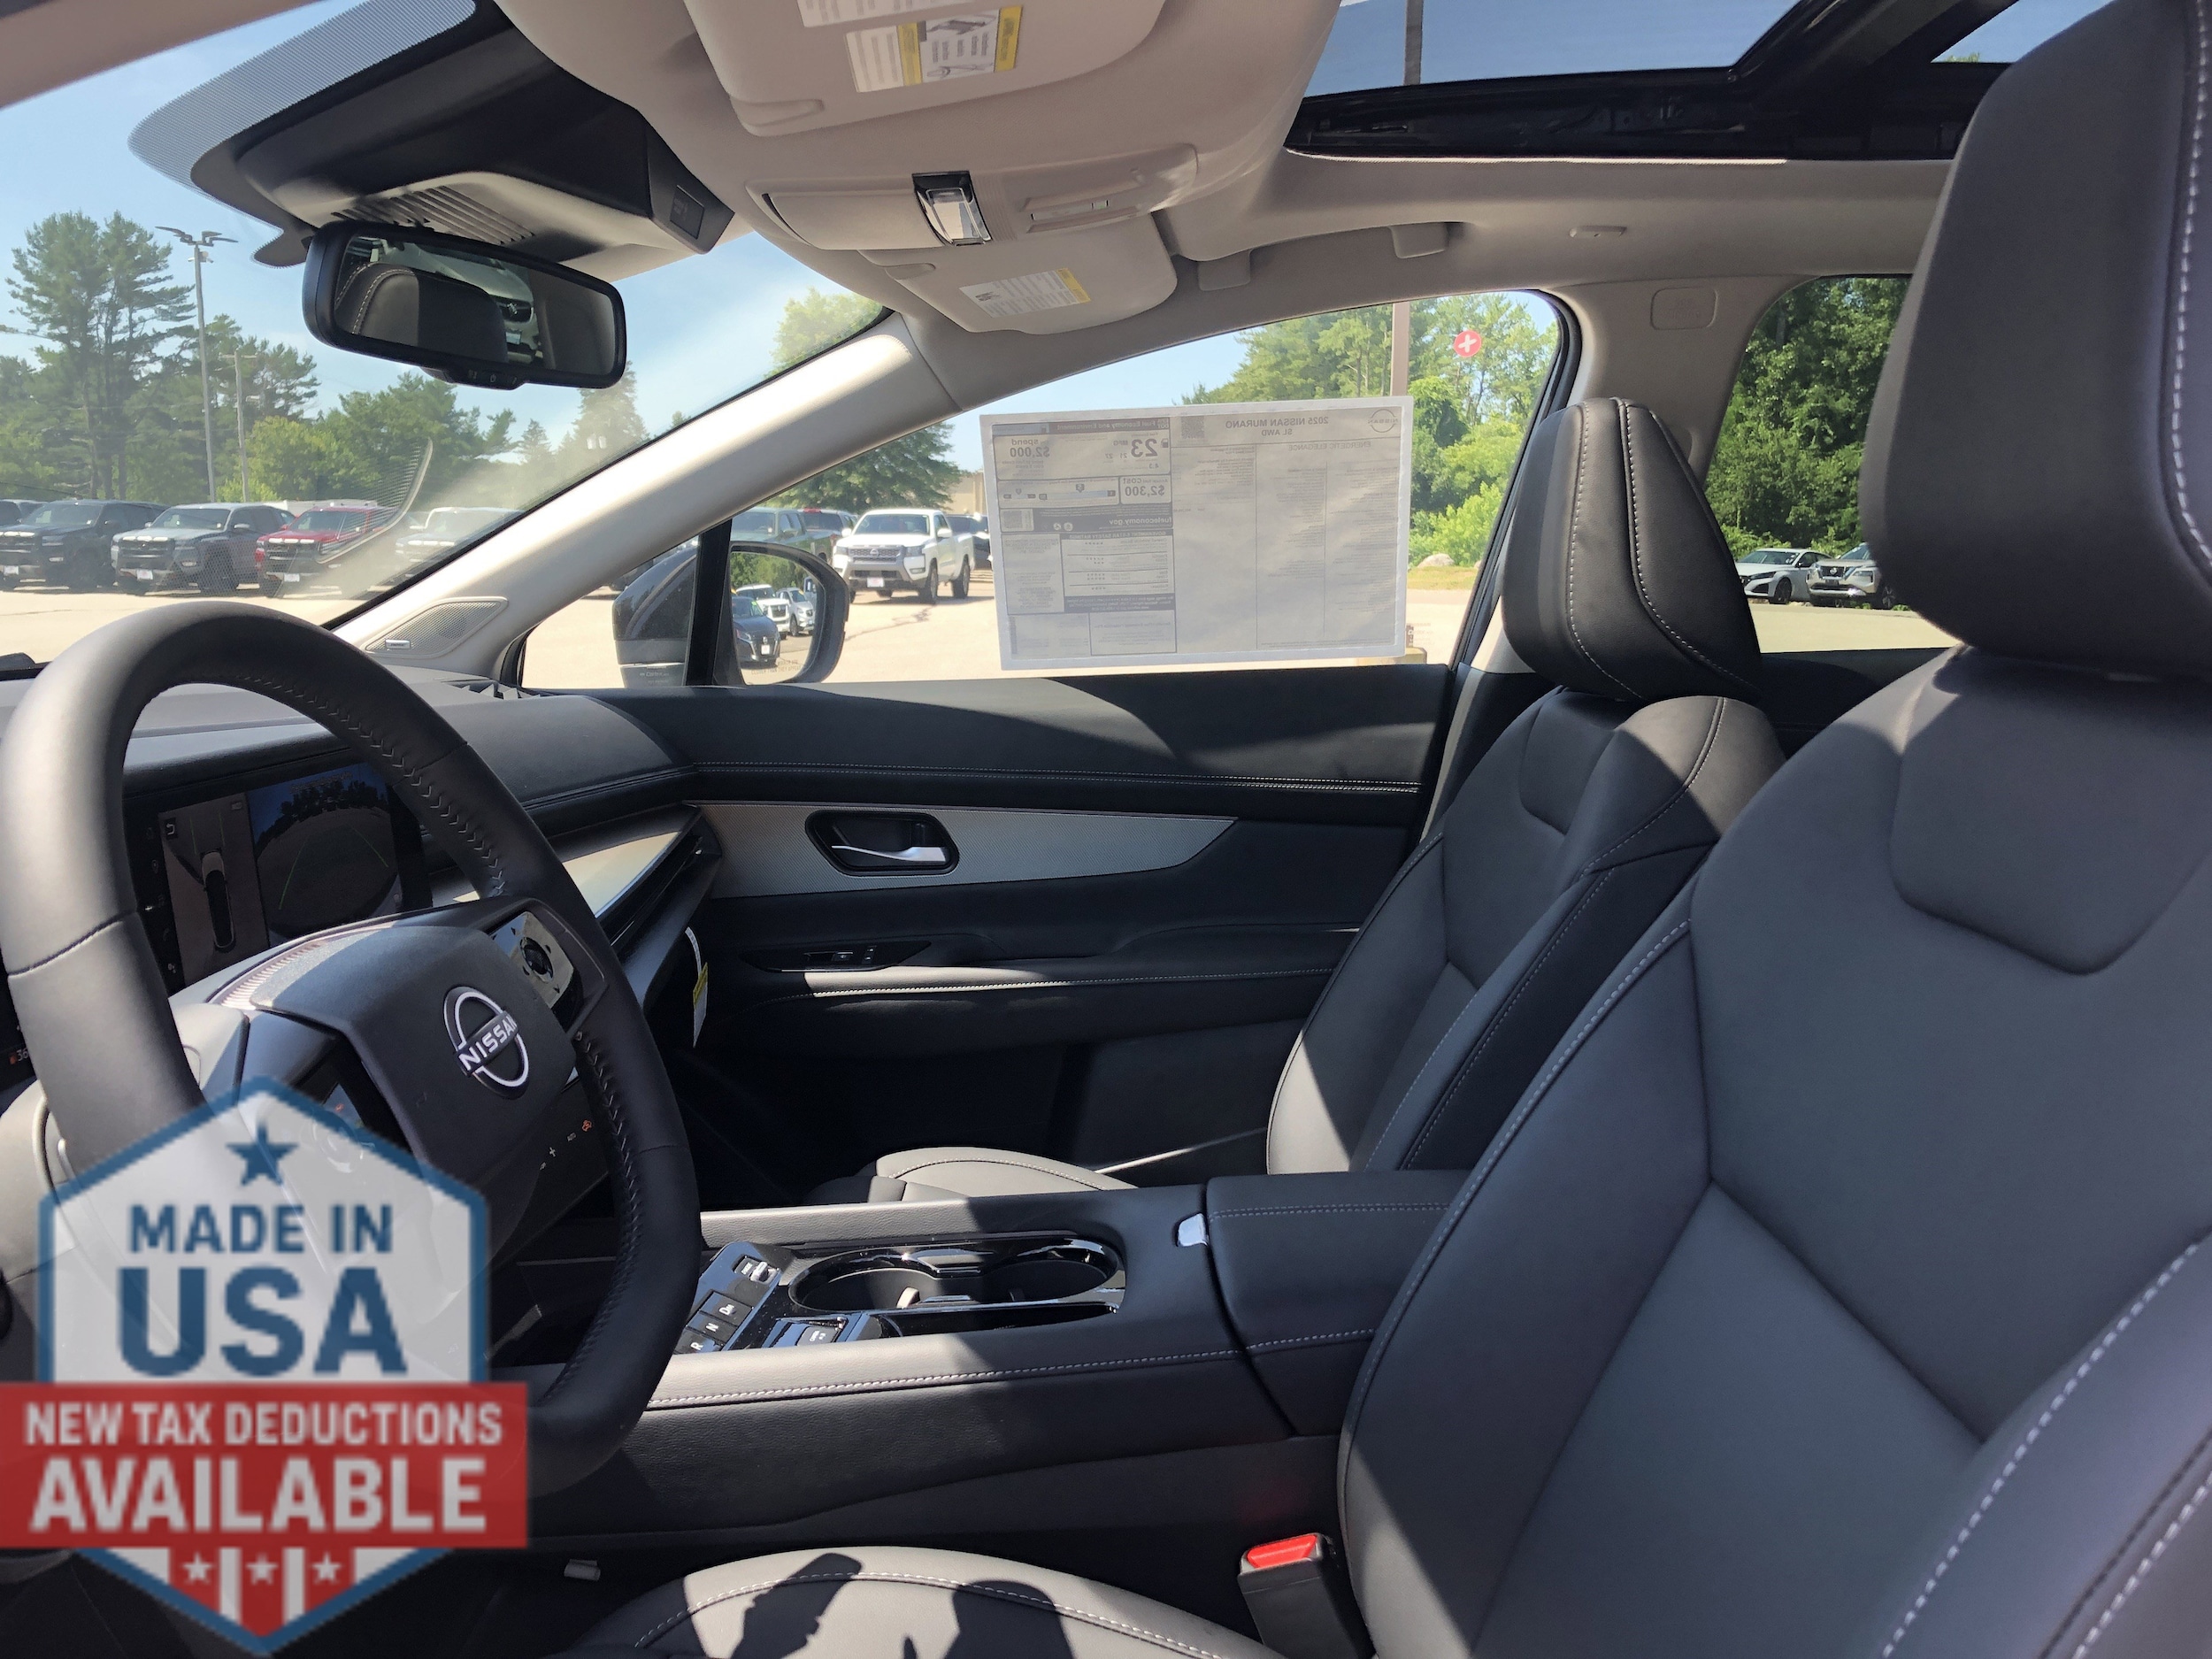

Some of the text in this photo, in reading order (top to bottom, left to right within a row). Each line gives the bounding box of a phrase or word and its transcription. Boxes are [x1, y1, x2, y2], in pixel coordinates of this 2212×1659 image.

[458, 1015, 518, 1071] NISSAN
[705, 1322, 719, 1333] N
[690, 1341, 704, 1351] R
